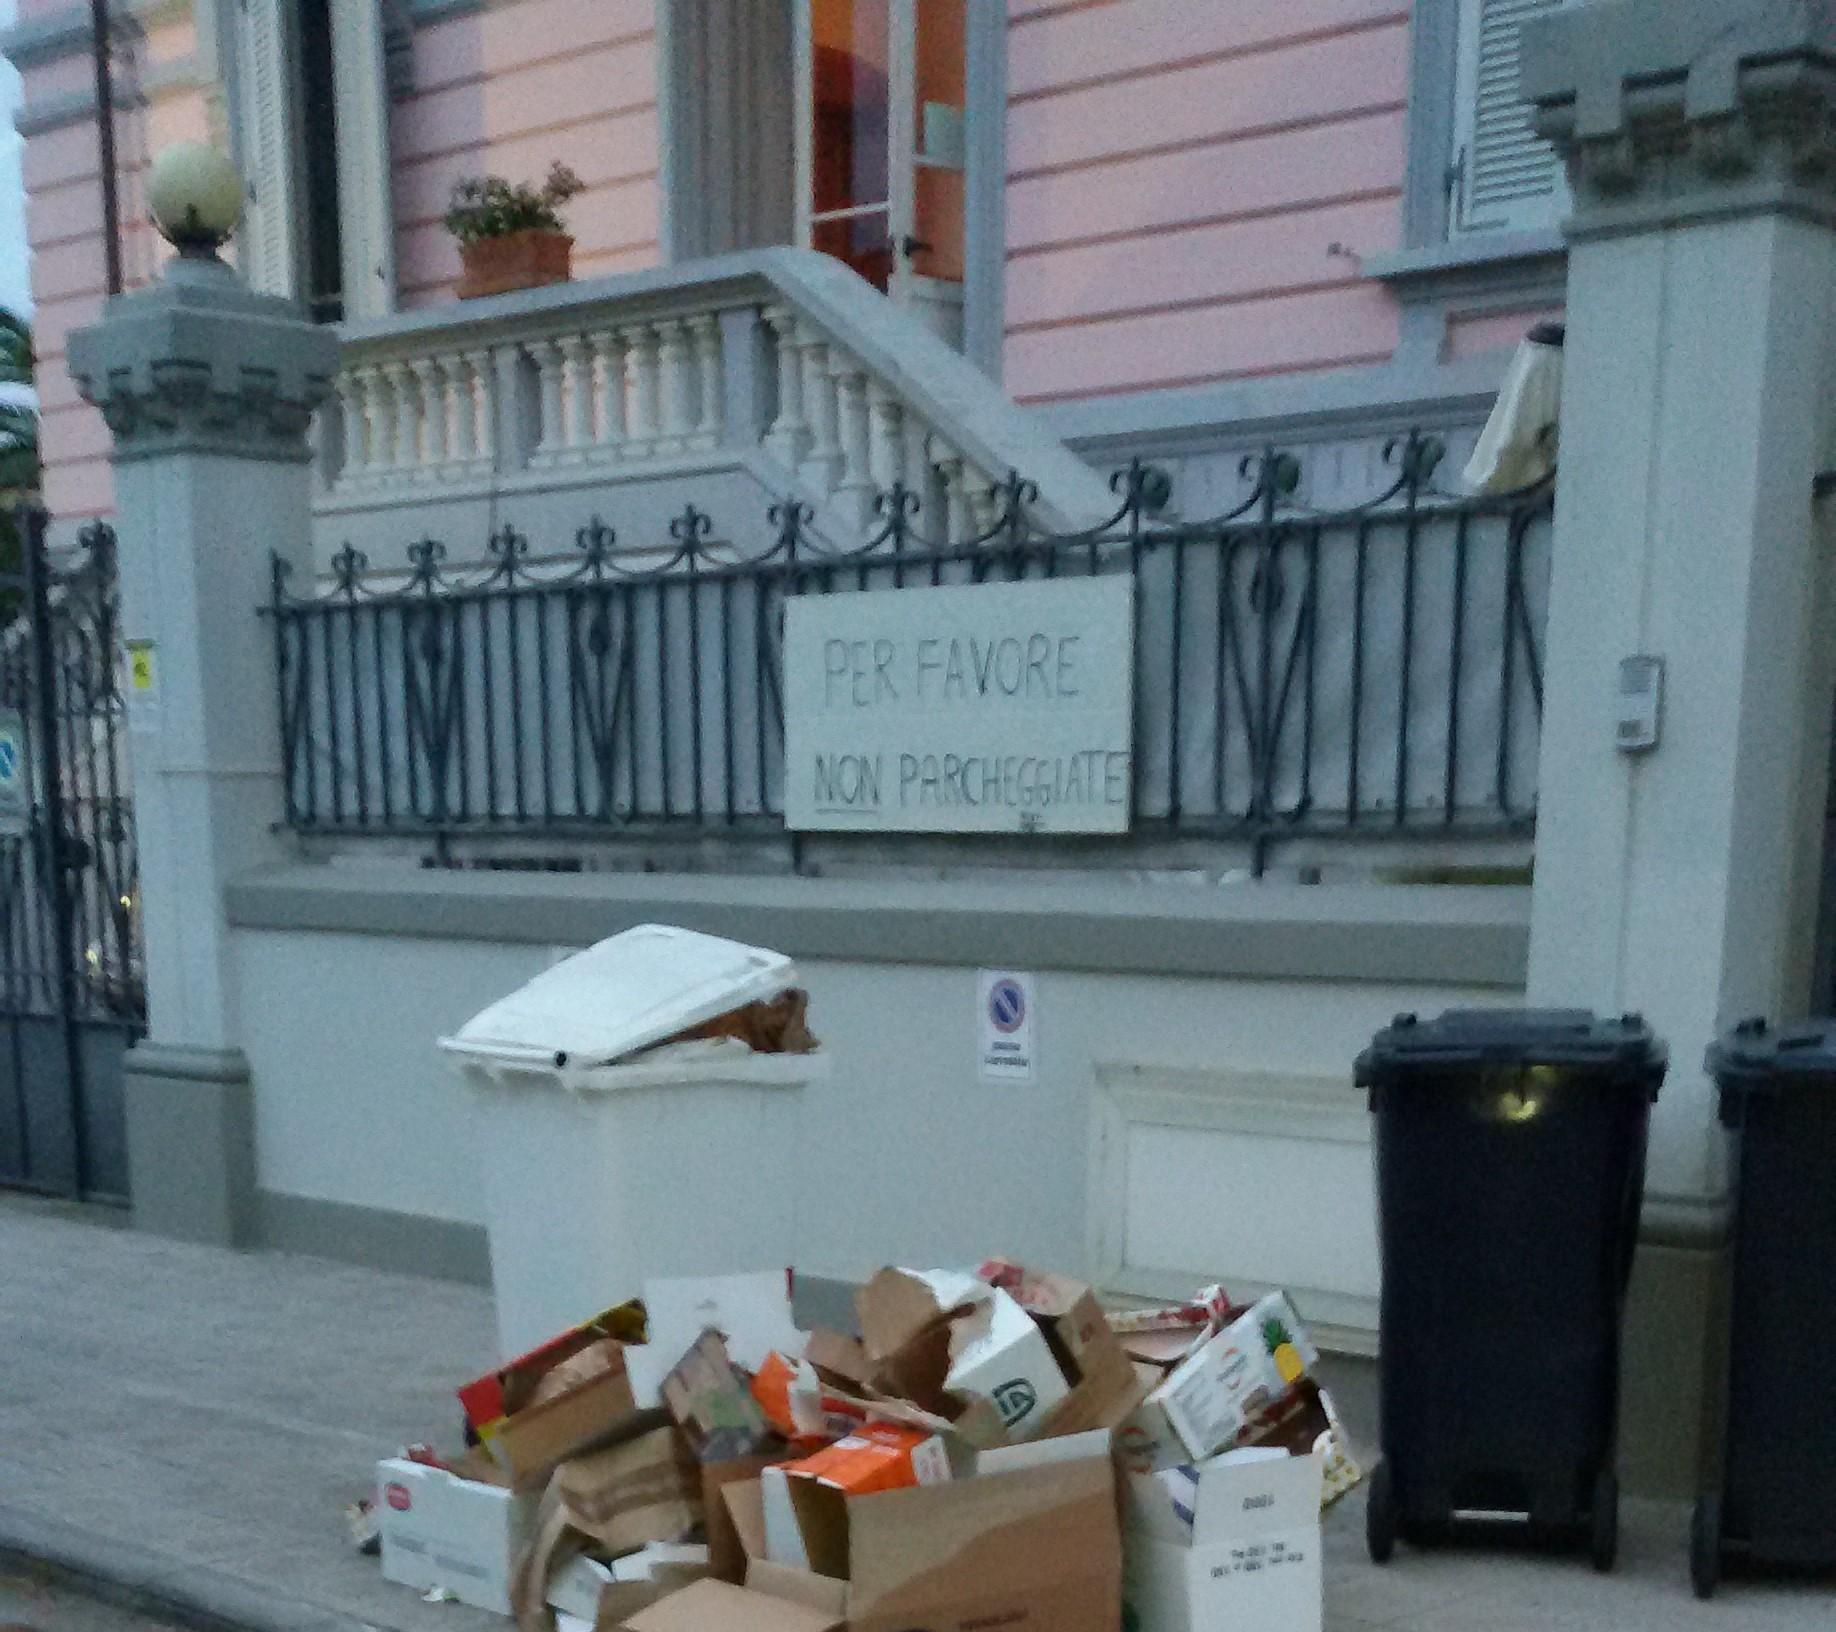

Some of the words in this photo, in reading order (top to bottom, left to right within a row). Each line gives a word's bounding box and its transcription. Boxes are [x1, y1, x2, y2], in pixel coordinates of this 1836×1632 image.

[824, 637, 898, 707] PER
[915, 633, 1081, 698] FAVORE
[814, 752, 881, 804] NON
[900, 750, 1131, 807] PARCHEGGIATE
